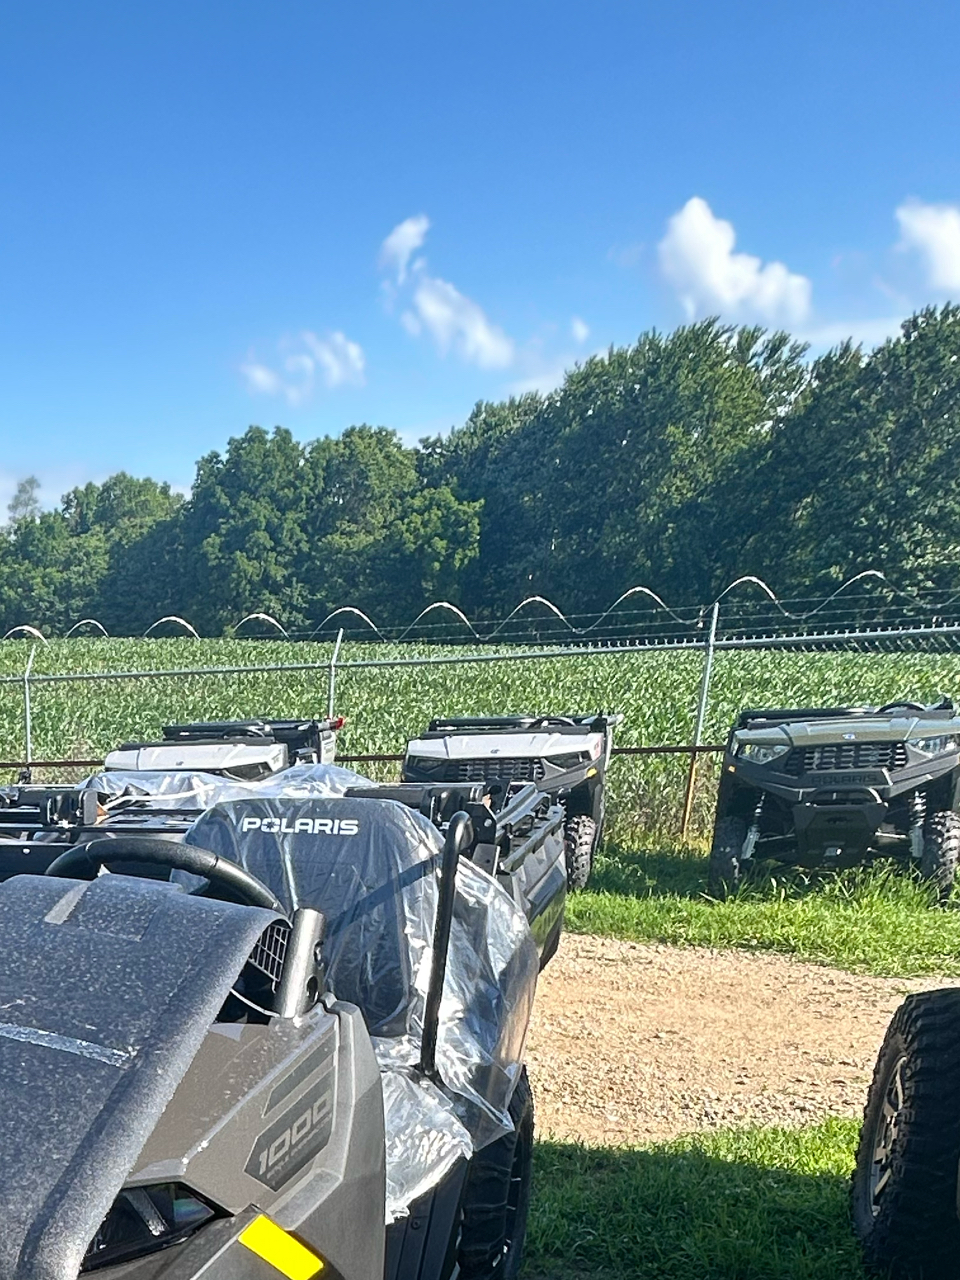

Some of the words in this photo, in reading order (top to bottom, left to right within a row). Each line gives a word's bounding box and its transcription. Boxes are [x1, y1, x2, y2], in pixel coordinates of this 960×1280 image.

[813, 774, 877, 784] POLARIS
[242, 817, 359, 836] POLARIS
[259, 1088, 332, 1176] 1000
